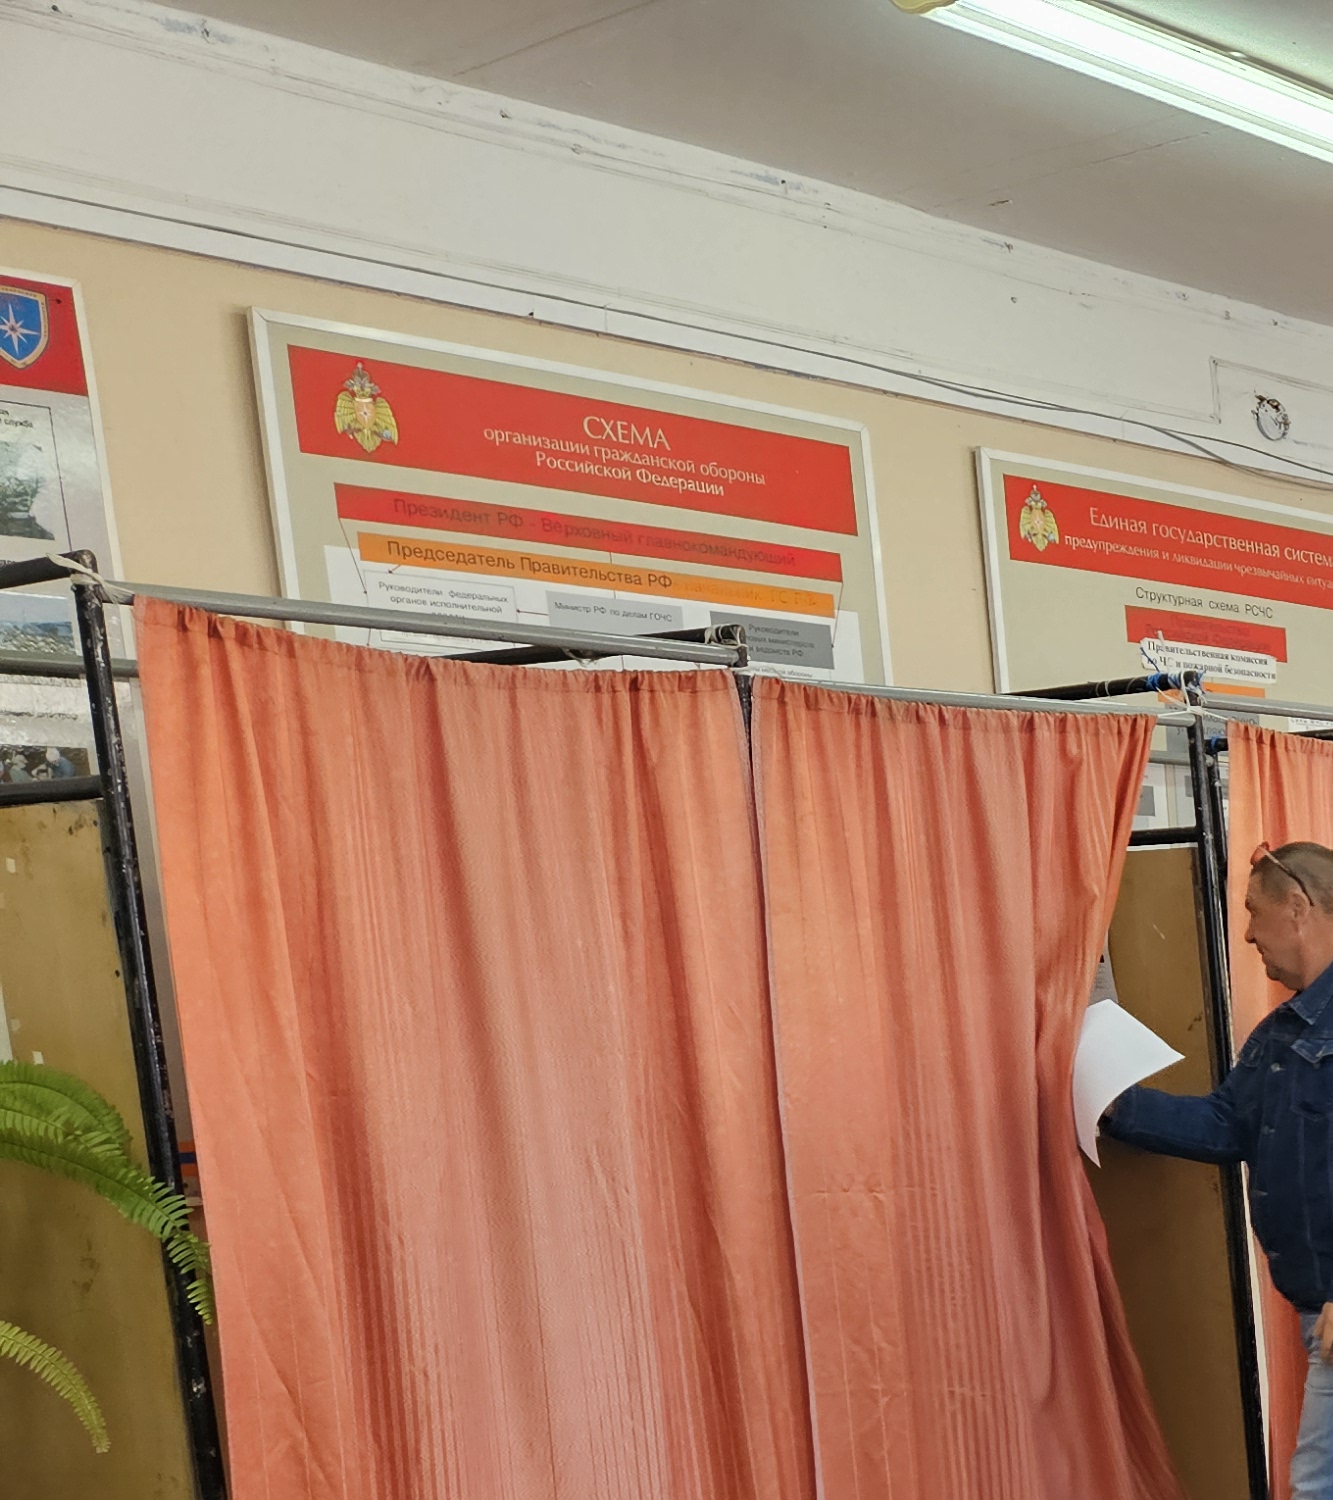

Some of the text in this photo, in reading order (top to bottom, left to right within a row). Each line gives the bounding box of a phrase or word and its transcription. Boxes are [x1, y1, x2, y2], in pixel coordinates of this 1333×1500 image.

[583, 416, 671, 450] СХЕМА
[484, 427, 766, 485] организации гражданской обороны
[536, 451, 725, 496] Российской Федерации
[393, 498, 490, 526] Президент
[497, 512, 524, 528] РФ
[541, 518, 633, 543] Верховный
[637, 534, 797, 567] главнокомандующий
[1089, 506, 1147, 534] Единая
[1152, 522, 1280, 559] государственная
[387, 540, 516, 570] Председатель
[520, 557, 643, 587] Правительства
[648, 573, 673, 589] РФ
[1064, 534, 1159, 560] предупреждения
[1162, 551, 1170, 561] и
[1172, 553, 1233, 573] ликвидации
[1233, 562, 1304, 584] чрезвычайных
[379, 581, 443, 597] Руководители
[1135, 586, 1274, 619] Структурная схема РСЧС
[593, 605, 607, 615] РФ
[610, 608, 621, 617] по
[649, 613, 673, 622] ГОЧС
[1148, 641, 1268, 666] Правительственная комиссия
[1183, 660, 1223, 676] пожарной
[1224, 664, 1276, 680] безопасности
